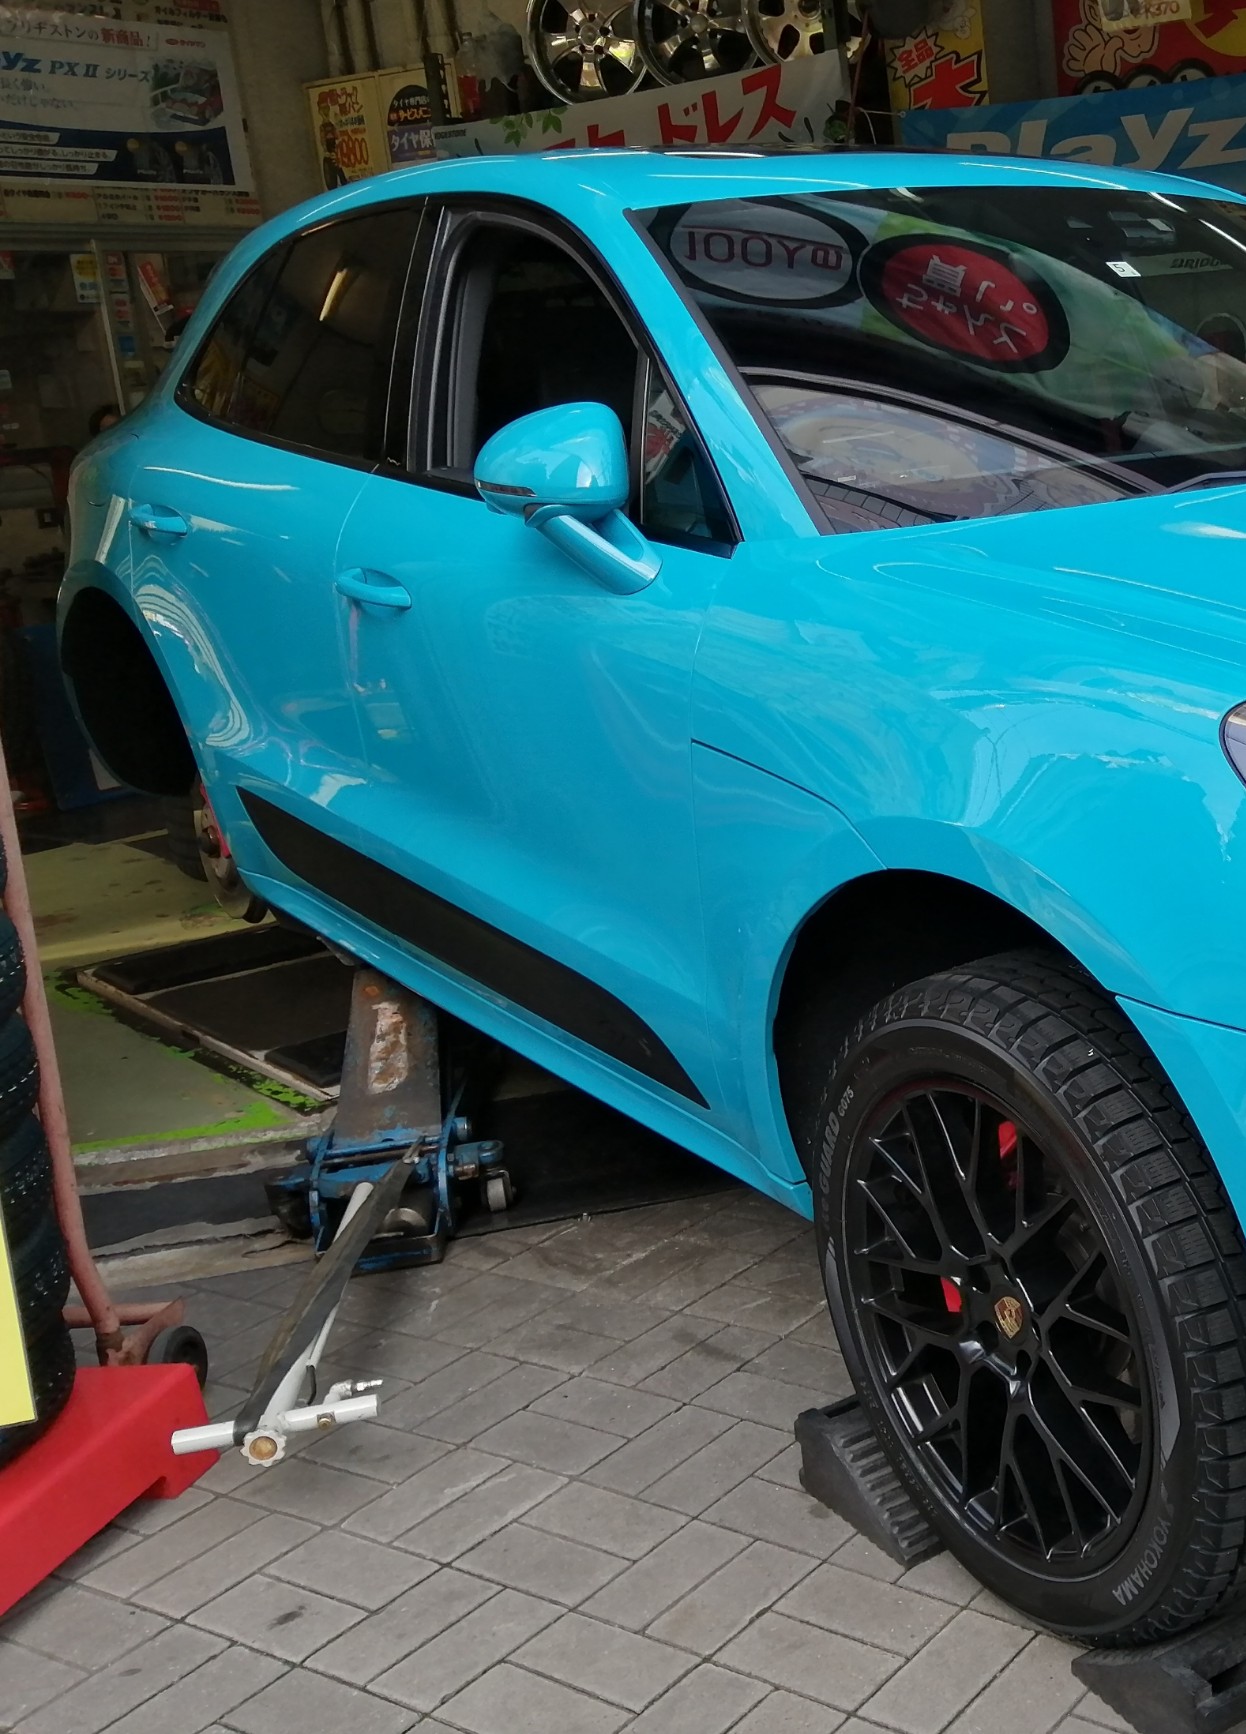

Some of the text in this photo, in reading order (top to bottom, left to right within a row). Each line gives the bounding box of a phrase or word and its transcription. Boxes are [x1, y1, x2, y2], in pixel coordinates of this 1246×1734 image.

[48, 60, 80, 78] PX
[897, 38, 935, 74] 全品
[391, 129, 433, 152] タイヤ保
[1112, 1516, 1171, 1606] YOKOHAMA
